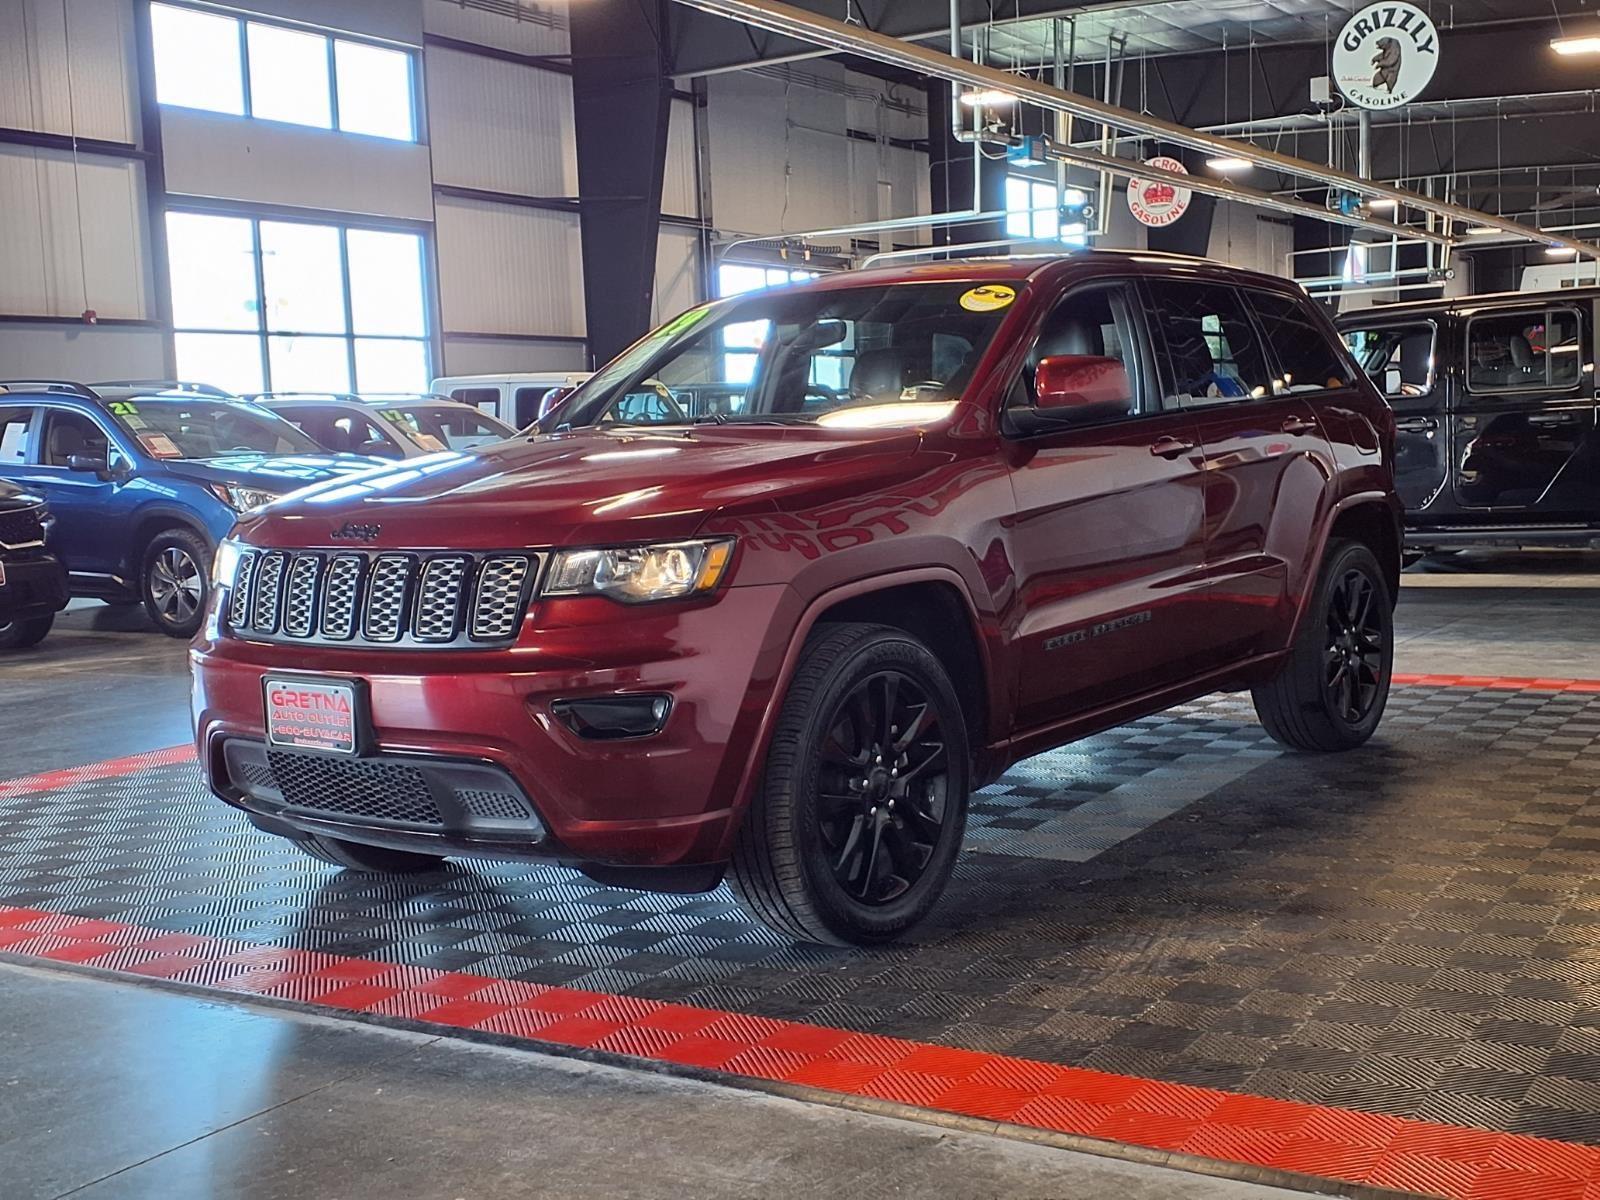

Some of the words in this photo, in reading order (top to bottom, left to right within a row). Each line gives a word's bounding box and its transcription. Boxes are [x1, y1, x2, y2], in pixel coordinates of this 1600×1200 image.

[1343, 8, 1434, 54] GRIZZLY
[1349, 89, 1408, 106] GASOLINE
[1131, 201, 1186, 225] GASOLINE
[108, 402, 139, 415] 21
[330, 521, 381, 543] Jeep
[271, 690, 350, 713] GRETNA
[272, 709, 304, 722] AUTO
[307, 712, 351, 727] OUTLET
